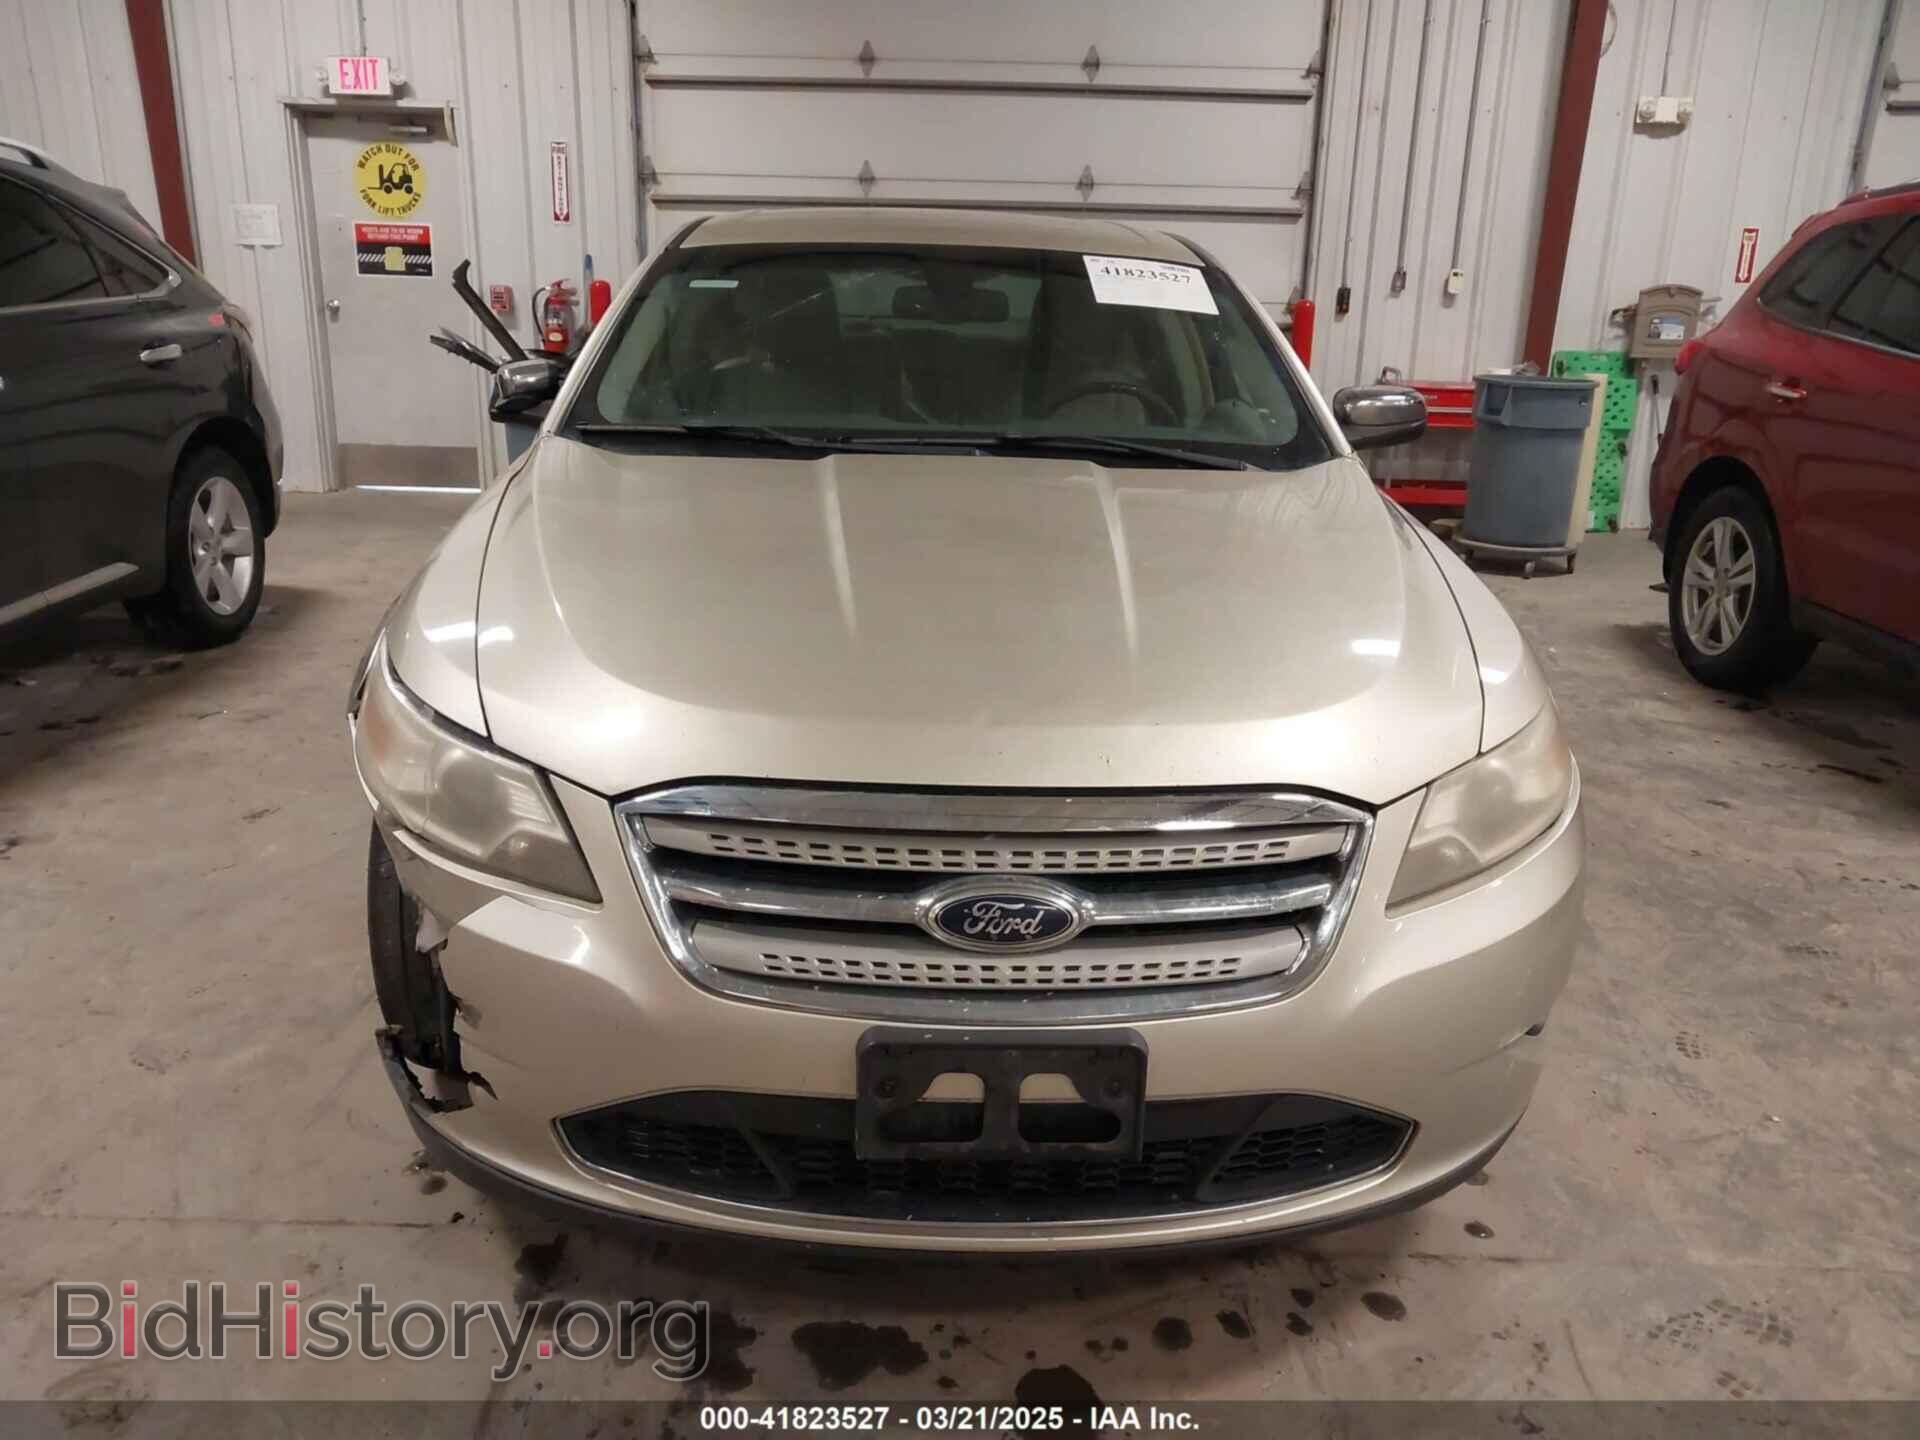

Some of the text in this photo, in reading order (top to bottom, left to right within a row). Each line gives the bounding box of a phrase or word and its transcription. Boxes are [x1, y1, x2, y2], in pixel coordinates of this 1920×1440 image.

[339, 58, 378, 90] EXIT
[357, 143, 420, 172] WATCH OUT FOR
[360, 188, 377, 209] FORK
[377, 205, 395, 216] LIFT
[1100, 266, 1191, 284] 41823527
[963, 901, 1045, 935] Ford
